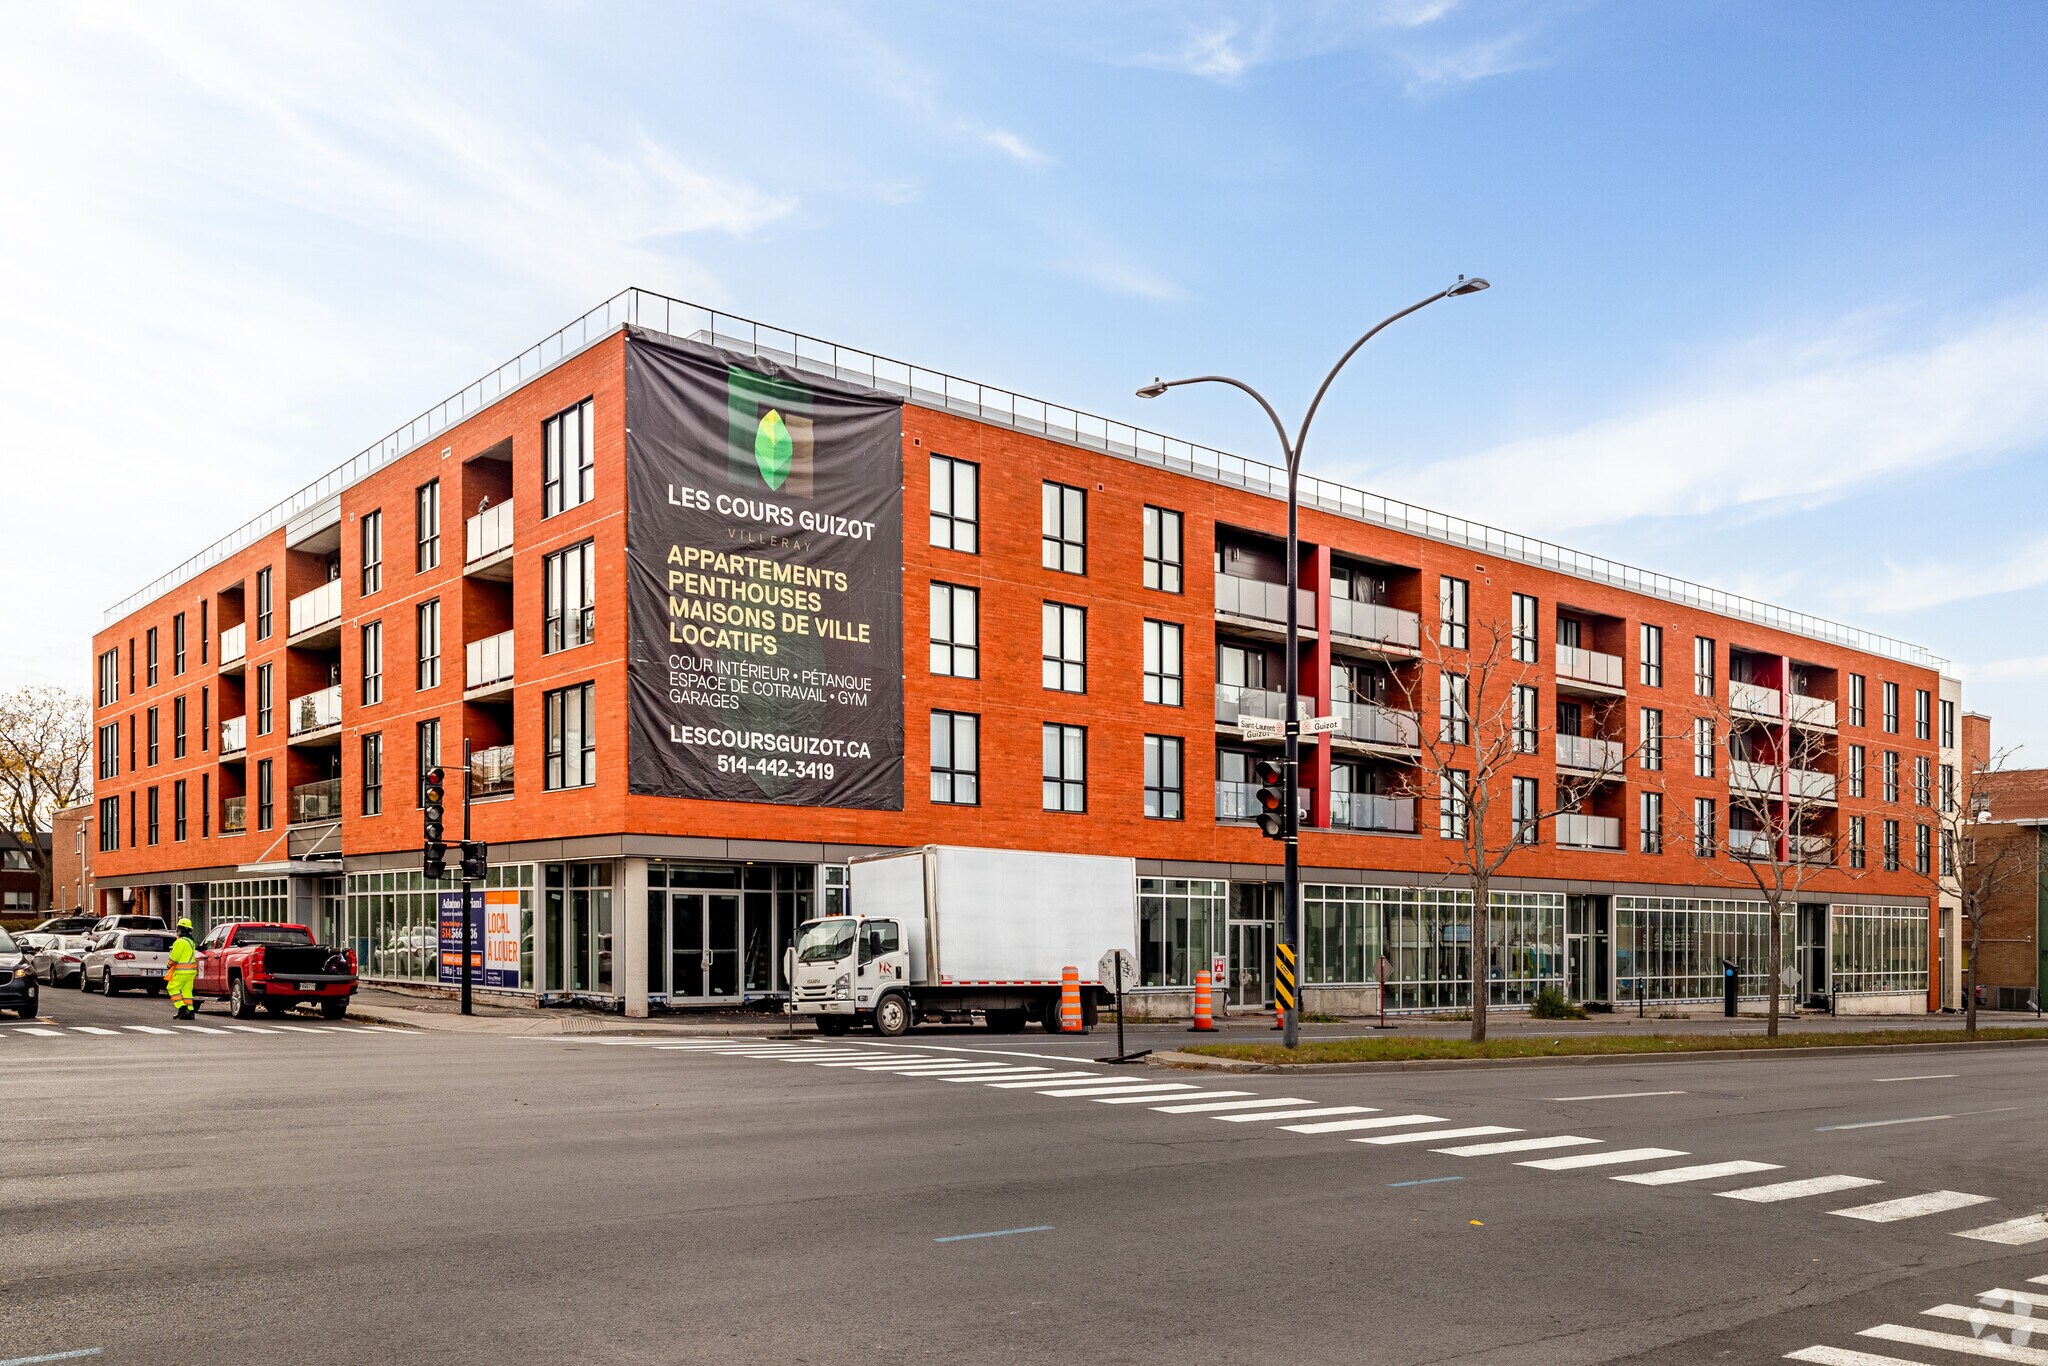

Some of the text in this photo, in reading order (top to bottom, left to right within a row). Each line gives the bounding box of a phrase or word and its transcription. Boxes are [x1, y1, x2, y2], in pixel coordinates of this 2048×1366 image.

[668, 484, 875, 541] LES COURS GUIZOT
[727, 528, 812, 552] VILLERAY
[667, 545, 848, 592] APPARTEMENTS
[668, 570, 822, 612] PENTHOUSES
[669, 596, 870, 643] MAISONS DE VILLE
[669, 622, 778, 655] LOCATIFS
[668, 654, 872, 692] COUR INTÉRIEUR PÉTANQUE
[669, 672, 868, 707] ESPACE DE COTRAVAIL GYM
[669, 689, 739, 710] GARAGES
[670, 724, 871, 759] LESCOURSGUIZOT.CA
[1241, 720, 1275, 732] Saint-Laurent
[1314, 721, 1338, 731] Guizot
[717, 754, 835, 780] 514-442-3419
[487, 913, 510, 934] LOCAL
[487, 936, 493, 961] À
[494, 941, 518, 962] LOUER
